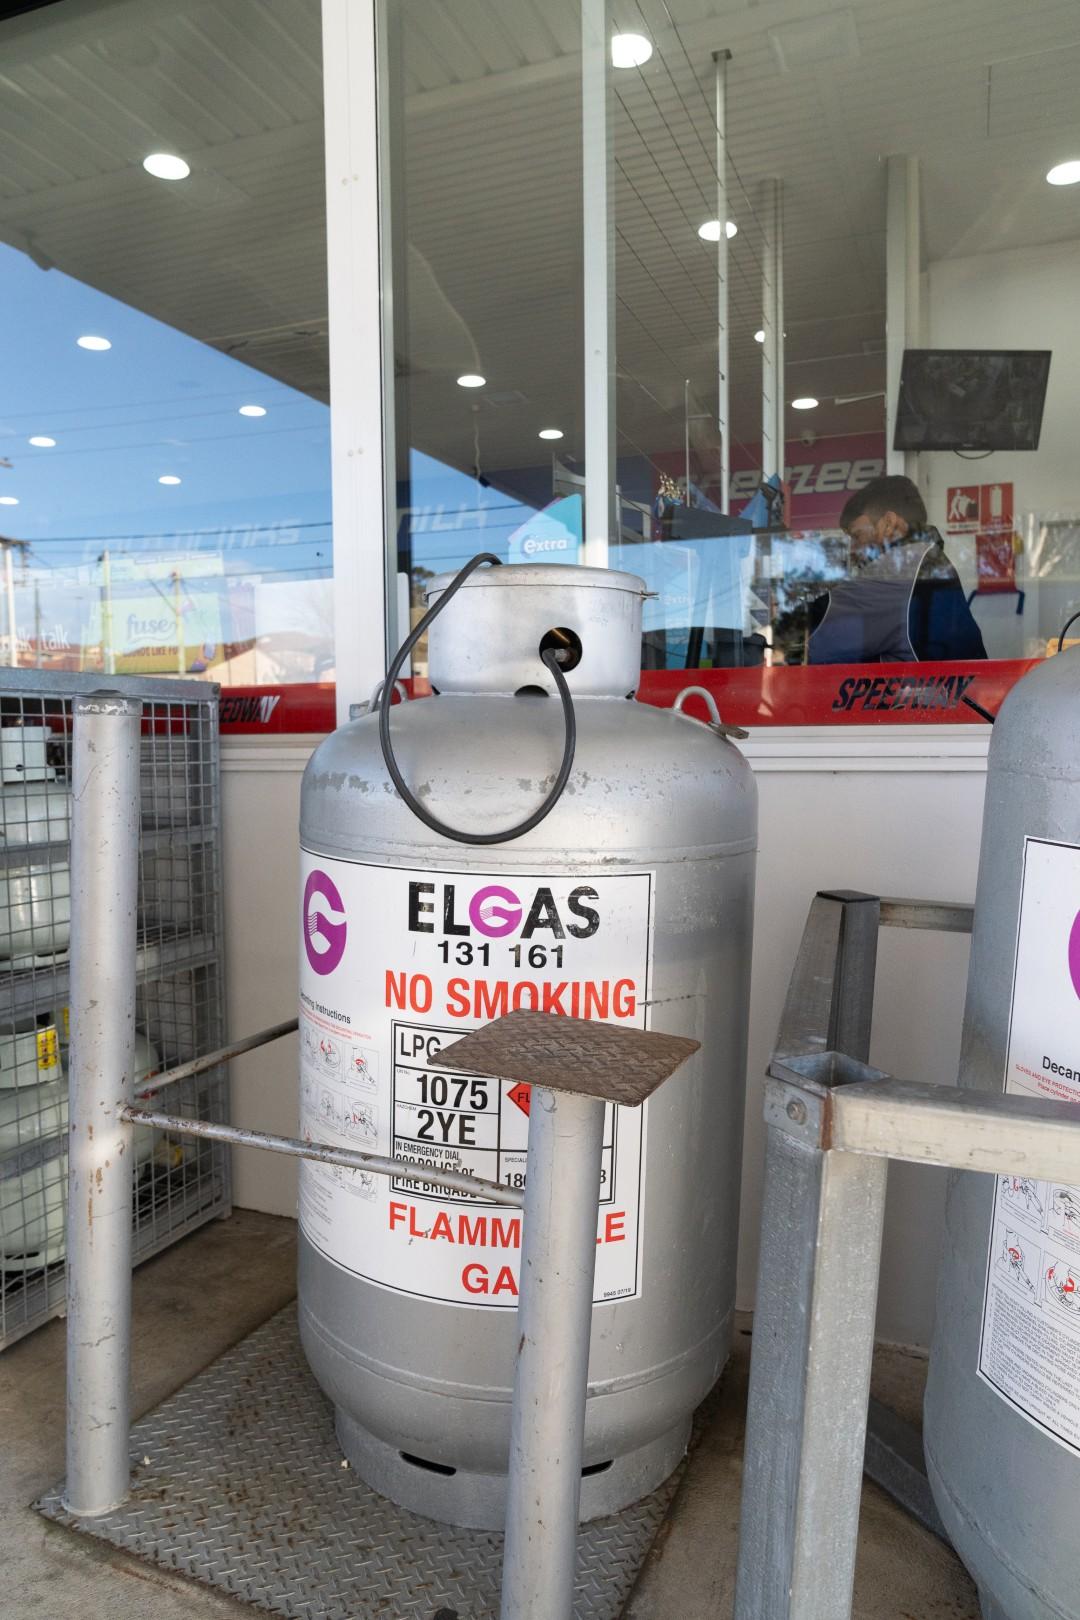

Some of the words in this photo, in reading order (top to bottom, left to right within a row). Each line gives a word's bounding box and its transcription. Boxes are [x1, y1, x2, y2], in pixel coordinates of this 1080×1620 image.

[832, 675, 975, 711] SPEEDWAY
[408, 881, 600, 939] ELGAS
[437, 940, 490, 967] 131
[508, 943, 564, 969] 161
[315, 1001, 351, 1024] Instructions
[385, 969, 433, 1014] NO
[446, 978, 636, 1020] SMOKING
[417, 1073, 488, 1111] 1075
[417, 1109, 476, 1146] 2YE
[395, 1140, 403, 1151] IN
[403, 1143, 443, 1158] EMERGENCY
[444, 1150, 460, 1161] DIAL
[389, 1201, 626, 1249] FLAMME
[461, 1263, 520, 1297] GA
